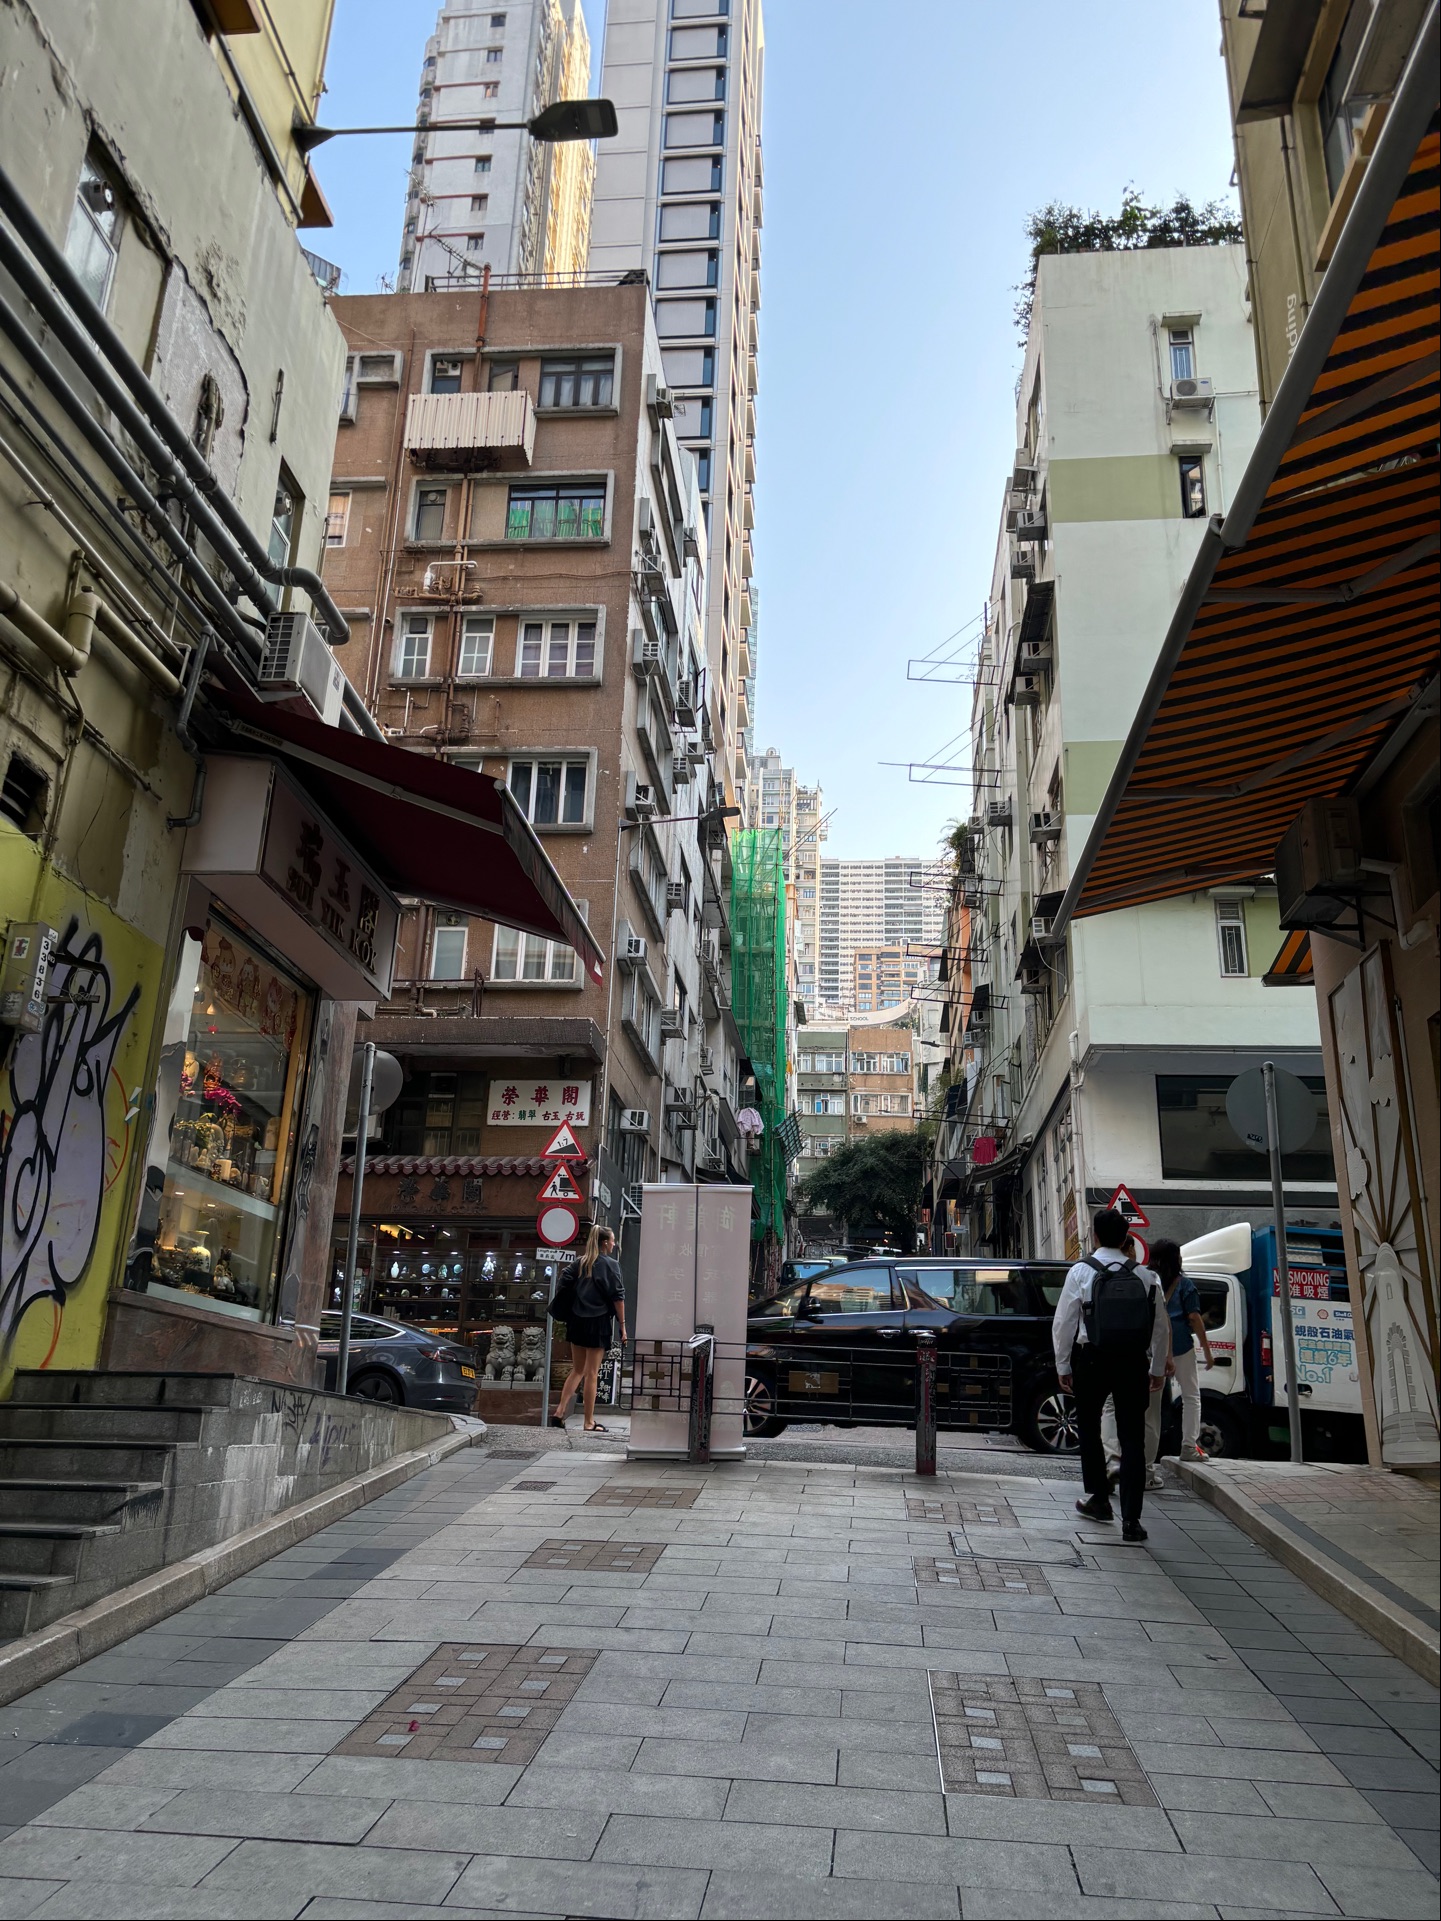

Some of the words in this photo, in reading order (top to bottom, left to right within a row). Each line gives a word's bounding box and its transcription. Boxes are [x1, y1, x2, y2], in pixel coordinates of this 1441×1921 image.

[286, 866, 315, 911] SUI
[320, 896, 345, 943] YIK
[348, 928, 377, 976] KOK
[34, 940, 50, 999] 33836
[501, 1085, 579, 1107] 榮華閣
[559, 1250, 575, 1261] 7m
[1288, 1271, 1330, 1286] SMOKING
[1294, 1325, 1355, 1340] 蜆殼石油氣
[1296, 1365, 1333, 1384] No.1
